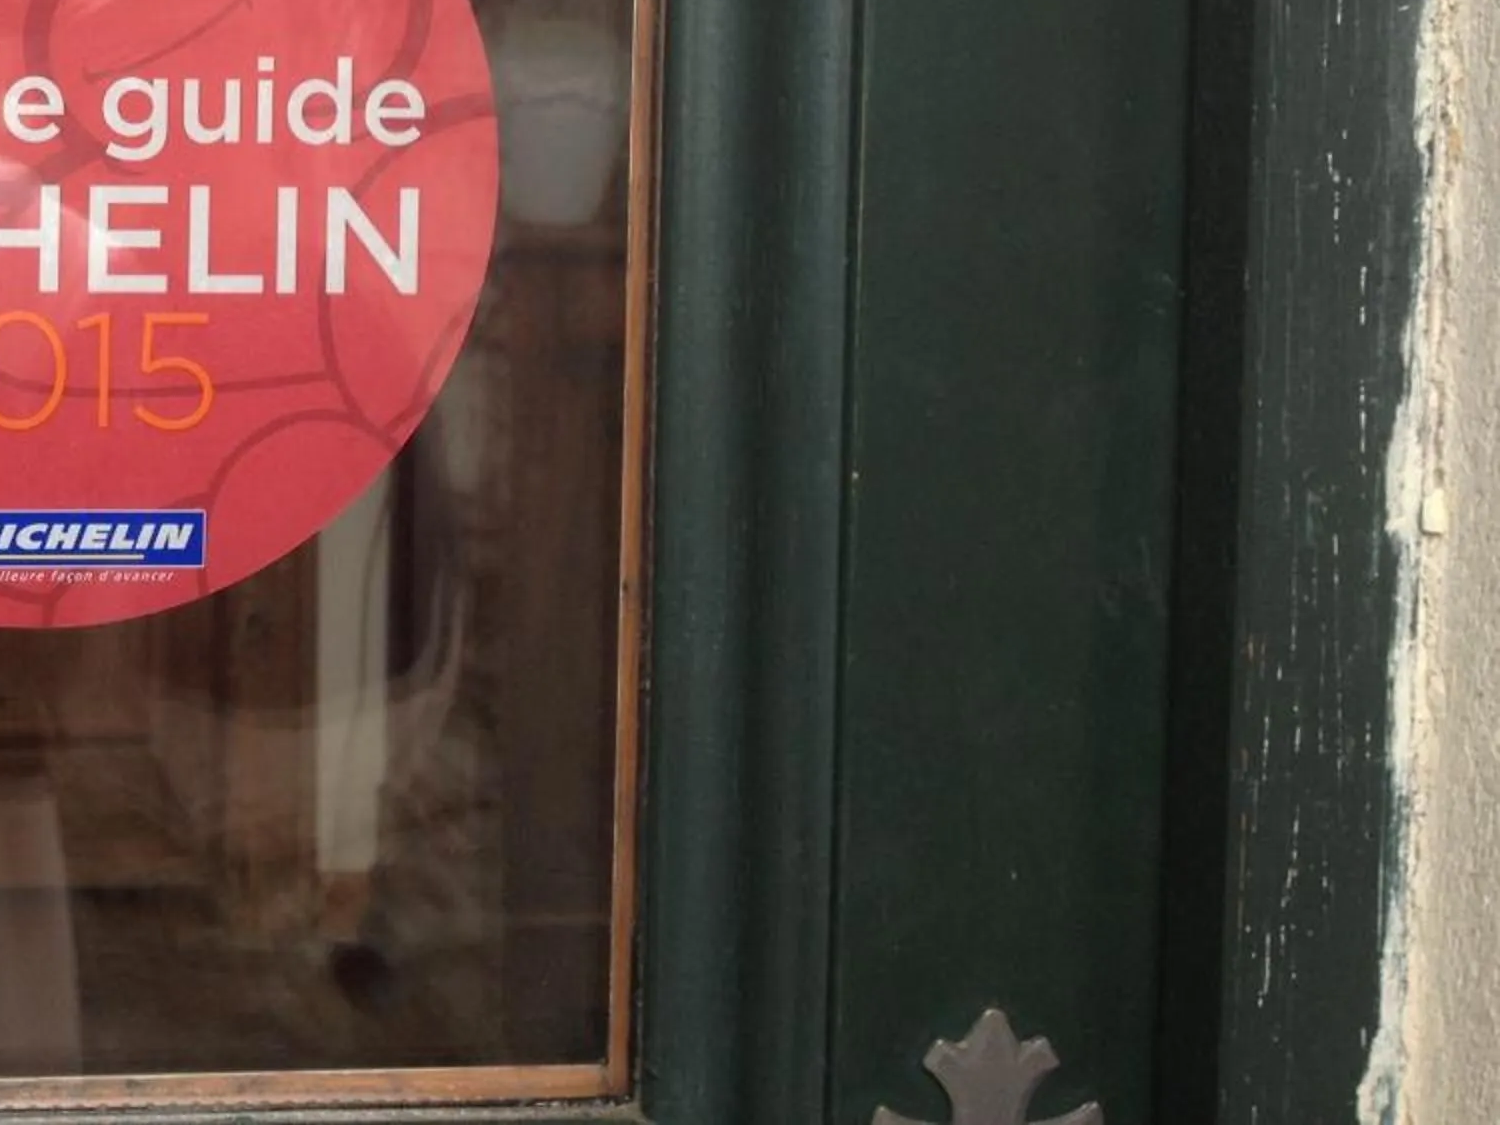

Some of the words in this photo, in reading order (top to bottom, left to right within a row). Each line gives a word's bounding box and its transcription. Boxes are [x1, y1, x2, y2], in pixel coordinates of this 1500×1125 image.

[100, 57, 426, 162] guide
[49, 569, 94, 585] façon
[98, 569, 176, 583] d'avancer
